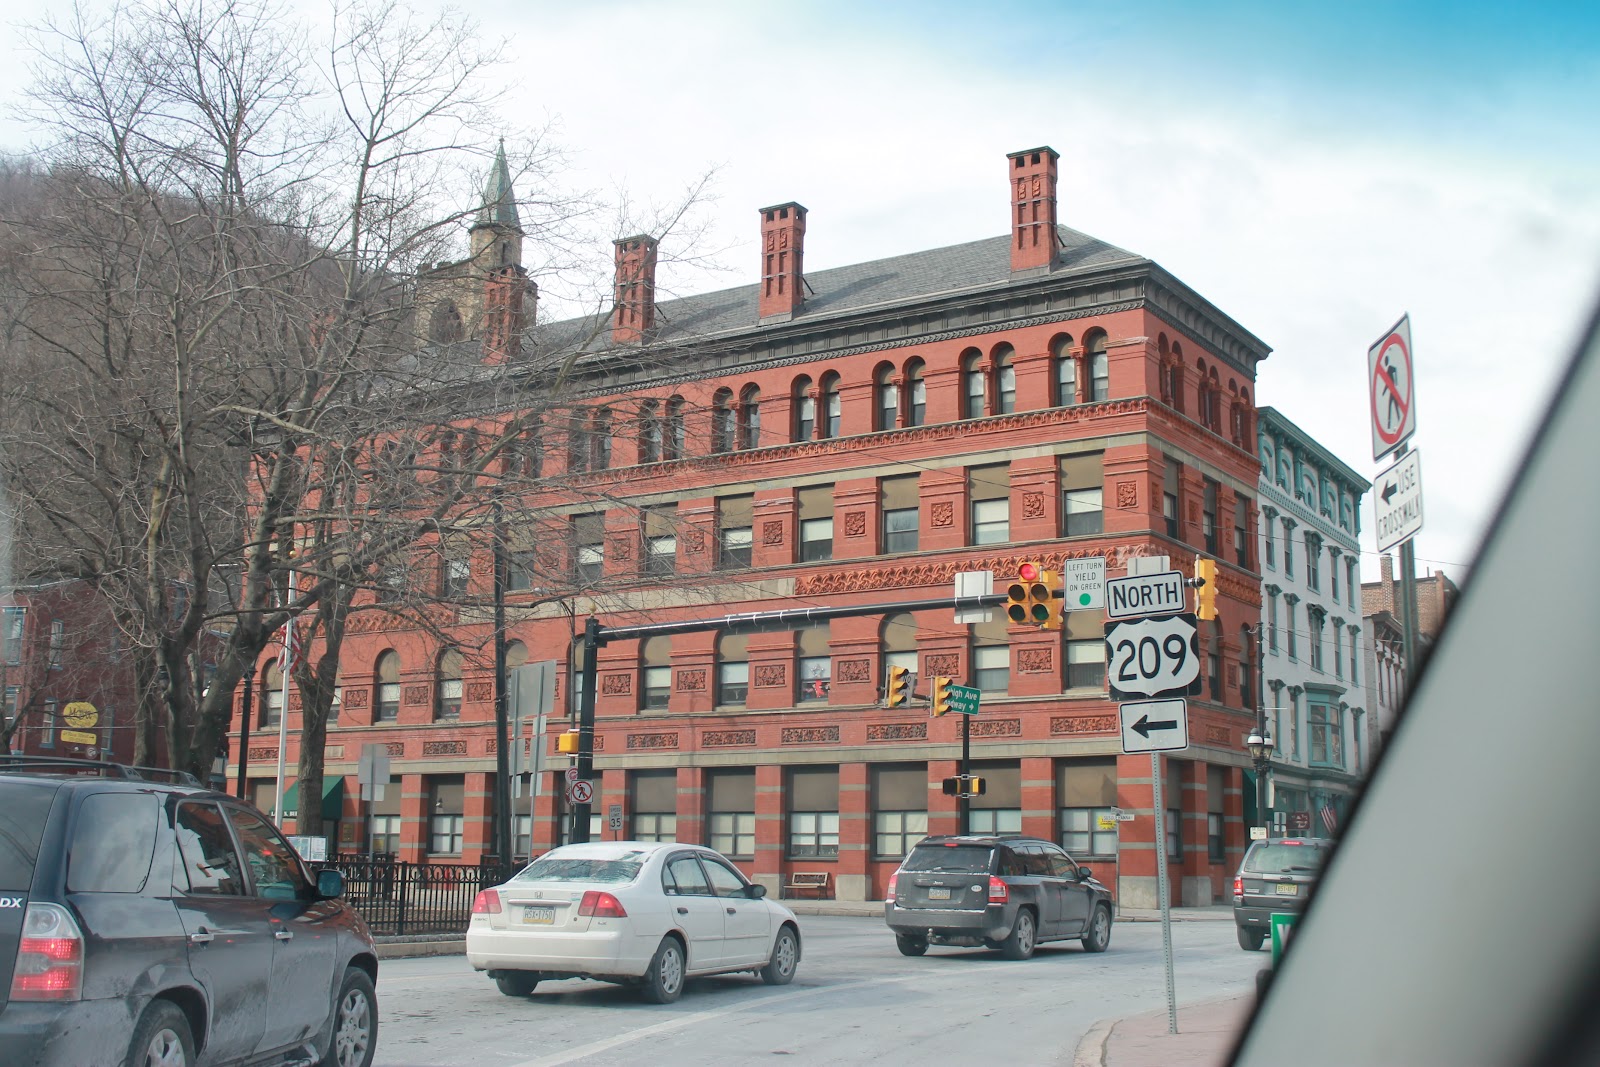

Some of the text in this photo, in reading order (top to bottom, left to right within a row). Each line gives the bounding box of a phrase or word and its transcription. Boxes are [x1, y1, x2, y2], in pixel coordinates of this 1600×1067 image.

[1399, 464, 1416, 494] USE
[1379, 496, 1420, 540] CROSSWALK
[1068, 562, 1102, 571] LEFT TURN
[1075, 572, 1096, 581] YIELD
[1113, 582, 1178, 609] NORTH
[1116, 633, 1187, 682] 209
[964, 690, 978, 701] Ave
[943, 699, 967, 712] oadway
[611, 818, 621, 828] 35
